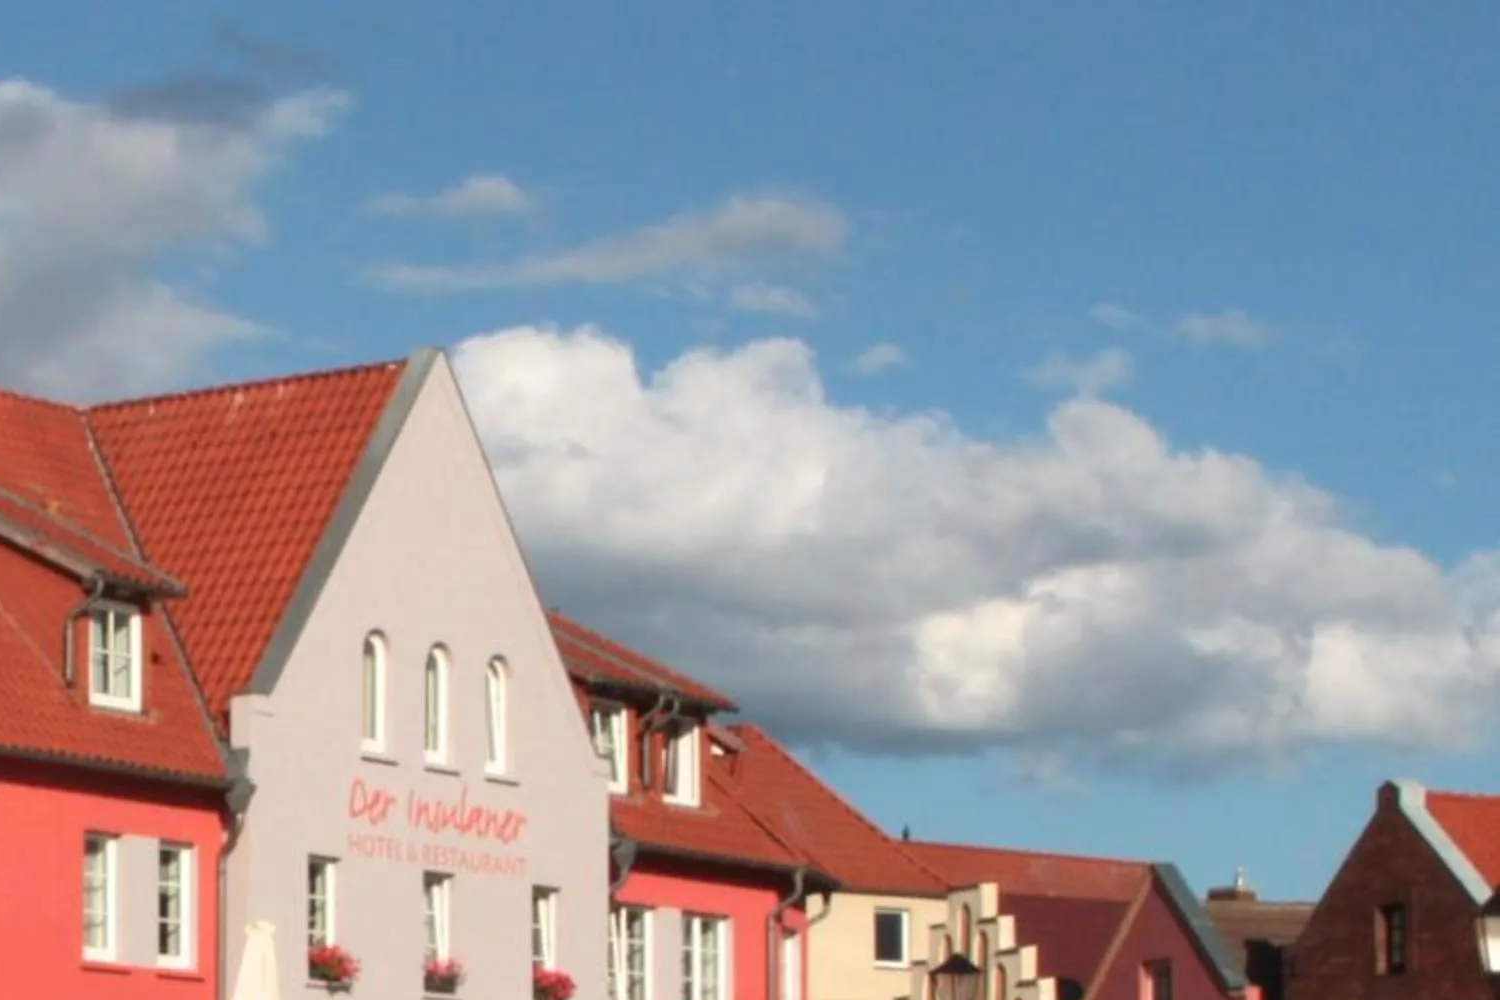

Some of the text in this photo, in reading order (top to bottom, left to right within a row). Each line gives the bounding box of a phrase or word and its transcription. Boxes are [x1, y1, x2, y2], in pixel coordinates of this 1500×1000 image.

[349, 777, 528, 843] Der Insulaner
[348, 833, 403, 863] HOTEL
[422, 842, 527, 876] RESTAURANT
